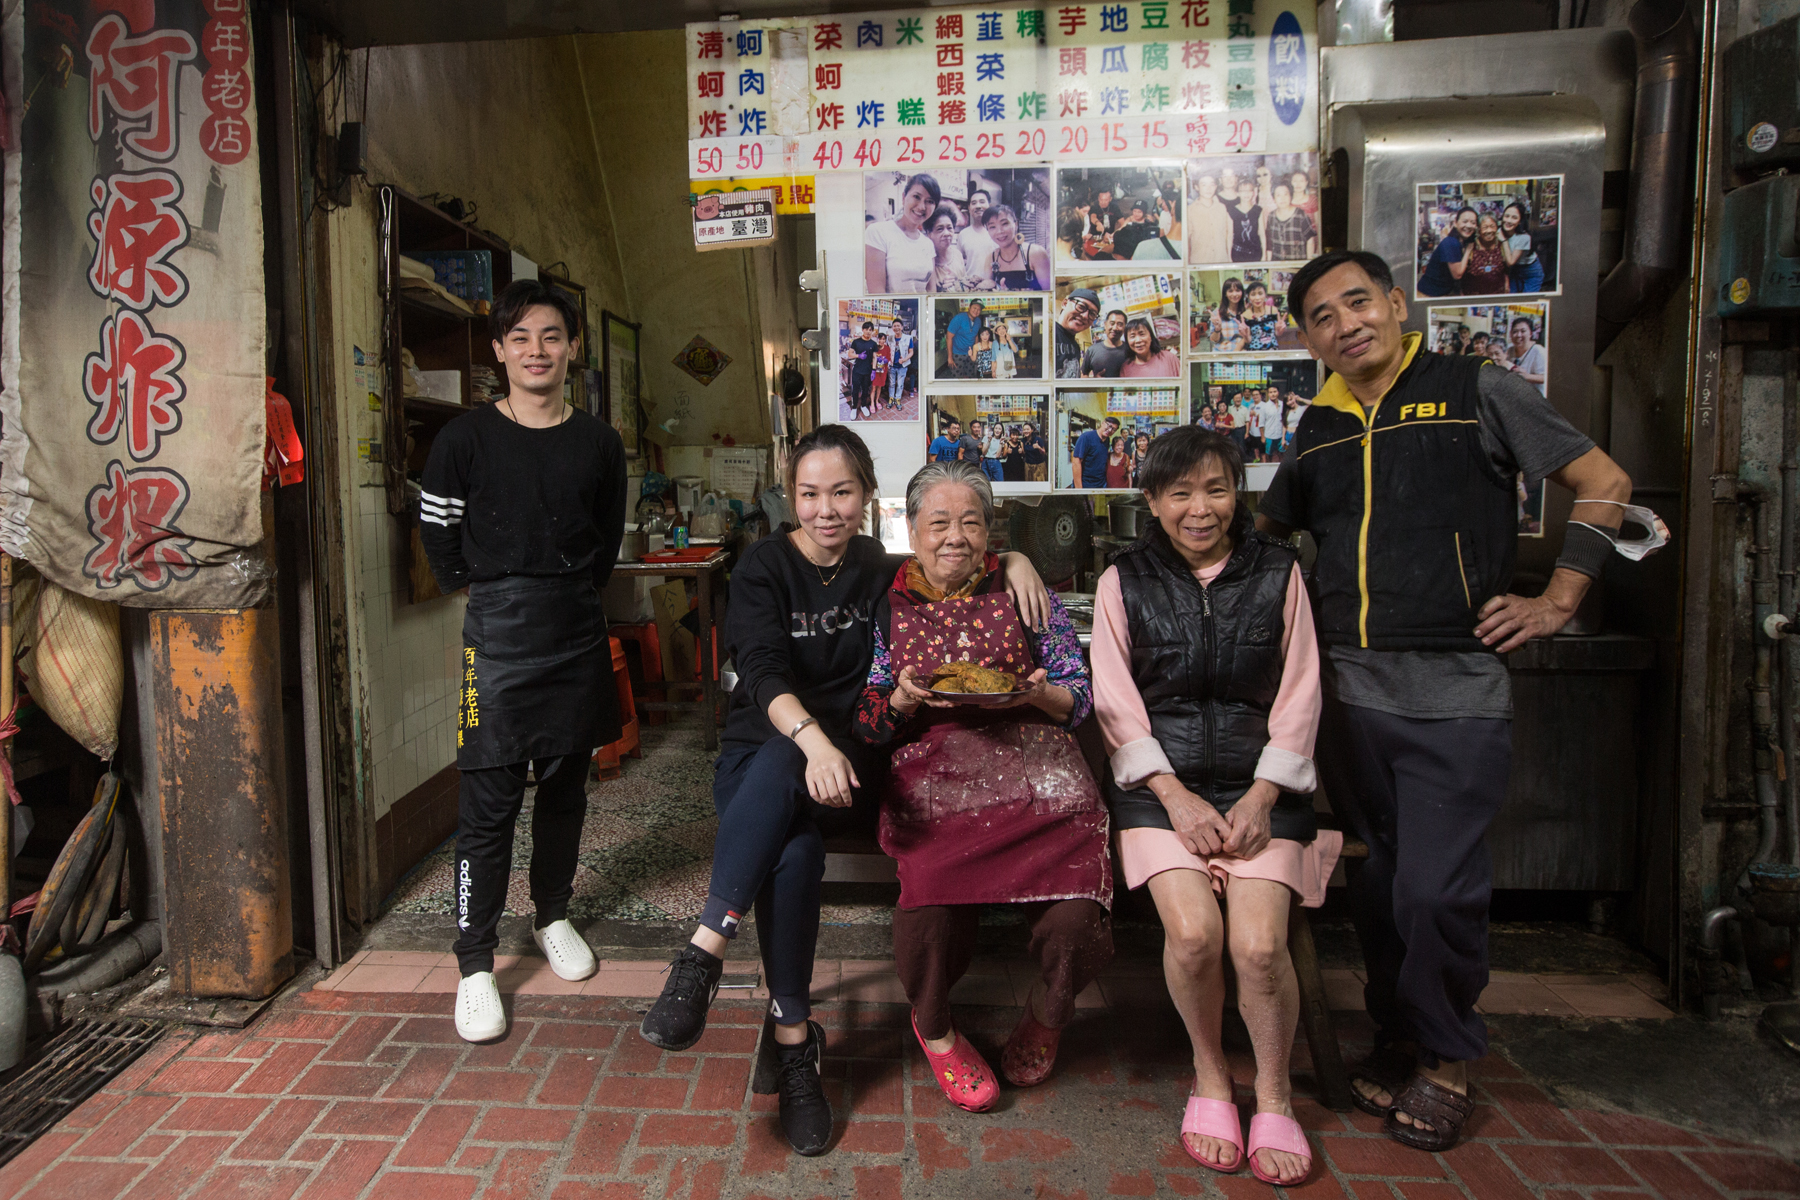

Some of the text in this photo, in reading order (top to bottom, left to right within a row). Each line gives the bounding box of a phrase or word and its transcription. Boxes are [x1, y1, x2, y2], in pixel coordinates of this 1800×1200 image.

[696, 30, 727, 138] 清蚵炸
[736, 28, 767, 136] 蚵肉炸
[814, 22, 845, 131] 菜蚵炸
[857, 20, 885, 128] 肉炸
[896, 17, 926, 126] 米糕
[935, 14, 966, 126] 網西蝦捲
[1016, 9, 1047, 120] 粿炸
[1058, 6, 1088, 117] 芋頭炸
[1099, 4, 1129, 115] 地瓜炸
[1140, 1, 1170, 112] 豆腐炸
[1181, 0, 1211, 110] 花枝炸
[1273, 33, 1300, 106] 飲料
[697, 147, 723, 173] 50
[735, 142, 763, 170] 50
[813, 140, 843, 169] 40
[853, 138, 882, 167] 40
[897, 136, 925, 163] 25
[939, 135, 967, 161] 25
[975, 133, 1005, 158] 25
[1015, 128, 1046, 155] 20
[1058, 125, 1088, 153] 20
[1100, 123, 1128, 151] 15
[1141, 120, 1169, 149] 15
[1224, 119, 1253, 148] 20
[698, 217, 768, 237] 原產地 臺灣
[84, 13, 197, 589] 阿源炸粿
[1400, 401, 1447, 421] FBI
[463, 647, 479, 729] 百年老店
[459, 859, 472, 914] adidas
